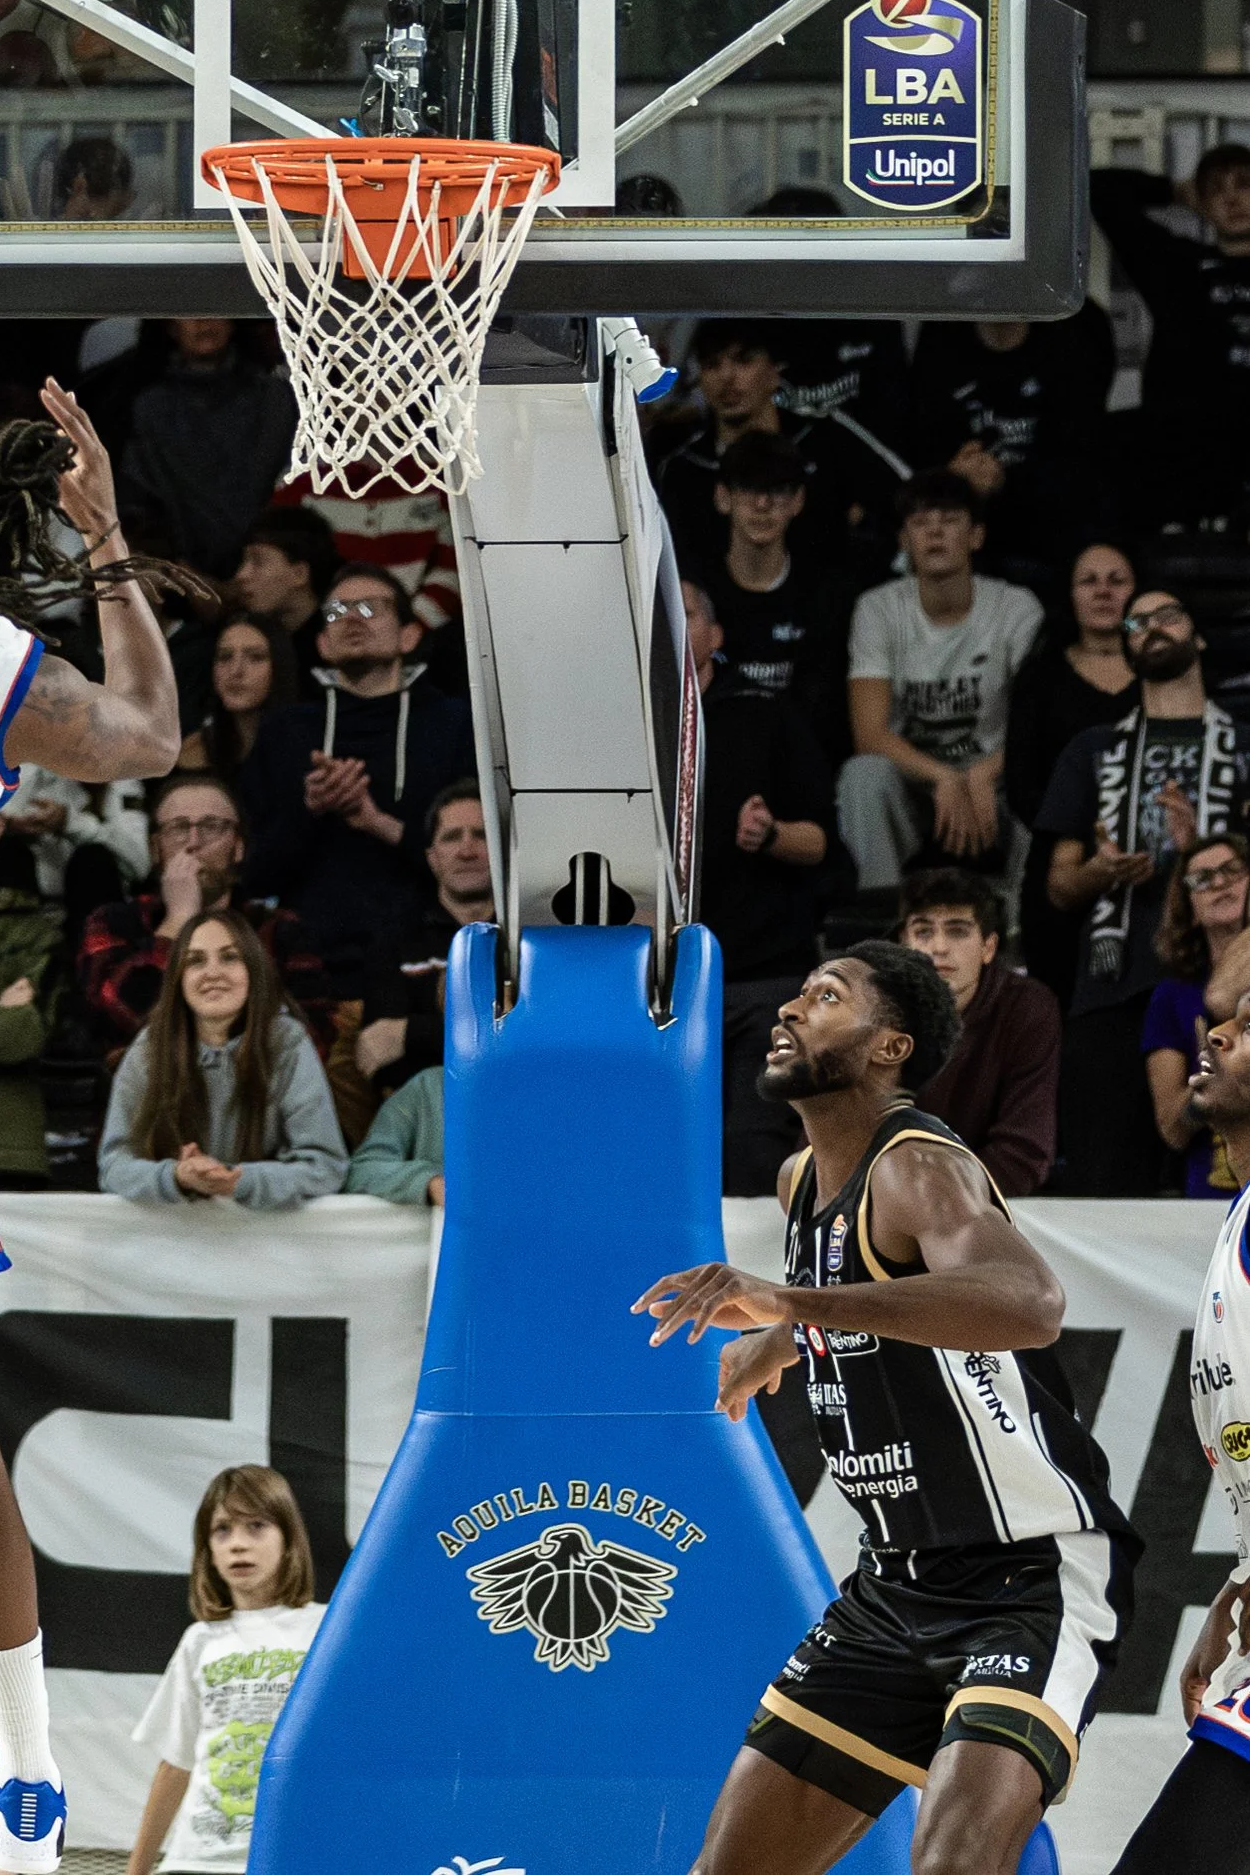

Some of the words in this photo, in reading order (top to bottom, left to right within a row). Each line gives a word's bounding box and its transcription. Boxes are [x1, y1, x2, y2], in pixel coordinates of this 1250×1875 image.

[864, 68, 966, 107] LBA
[881, 112, 927, 126] SERIE
[933, 112, 947, 126] A
[875, 150, 956, 186] Unipol
[828, 1440, 914, 1478] olomiti
[437, 1480, 558, 1559] AQUILA
[566, 1479, 709, 1554] BASKET
